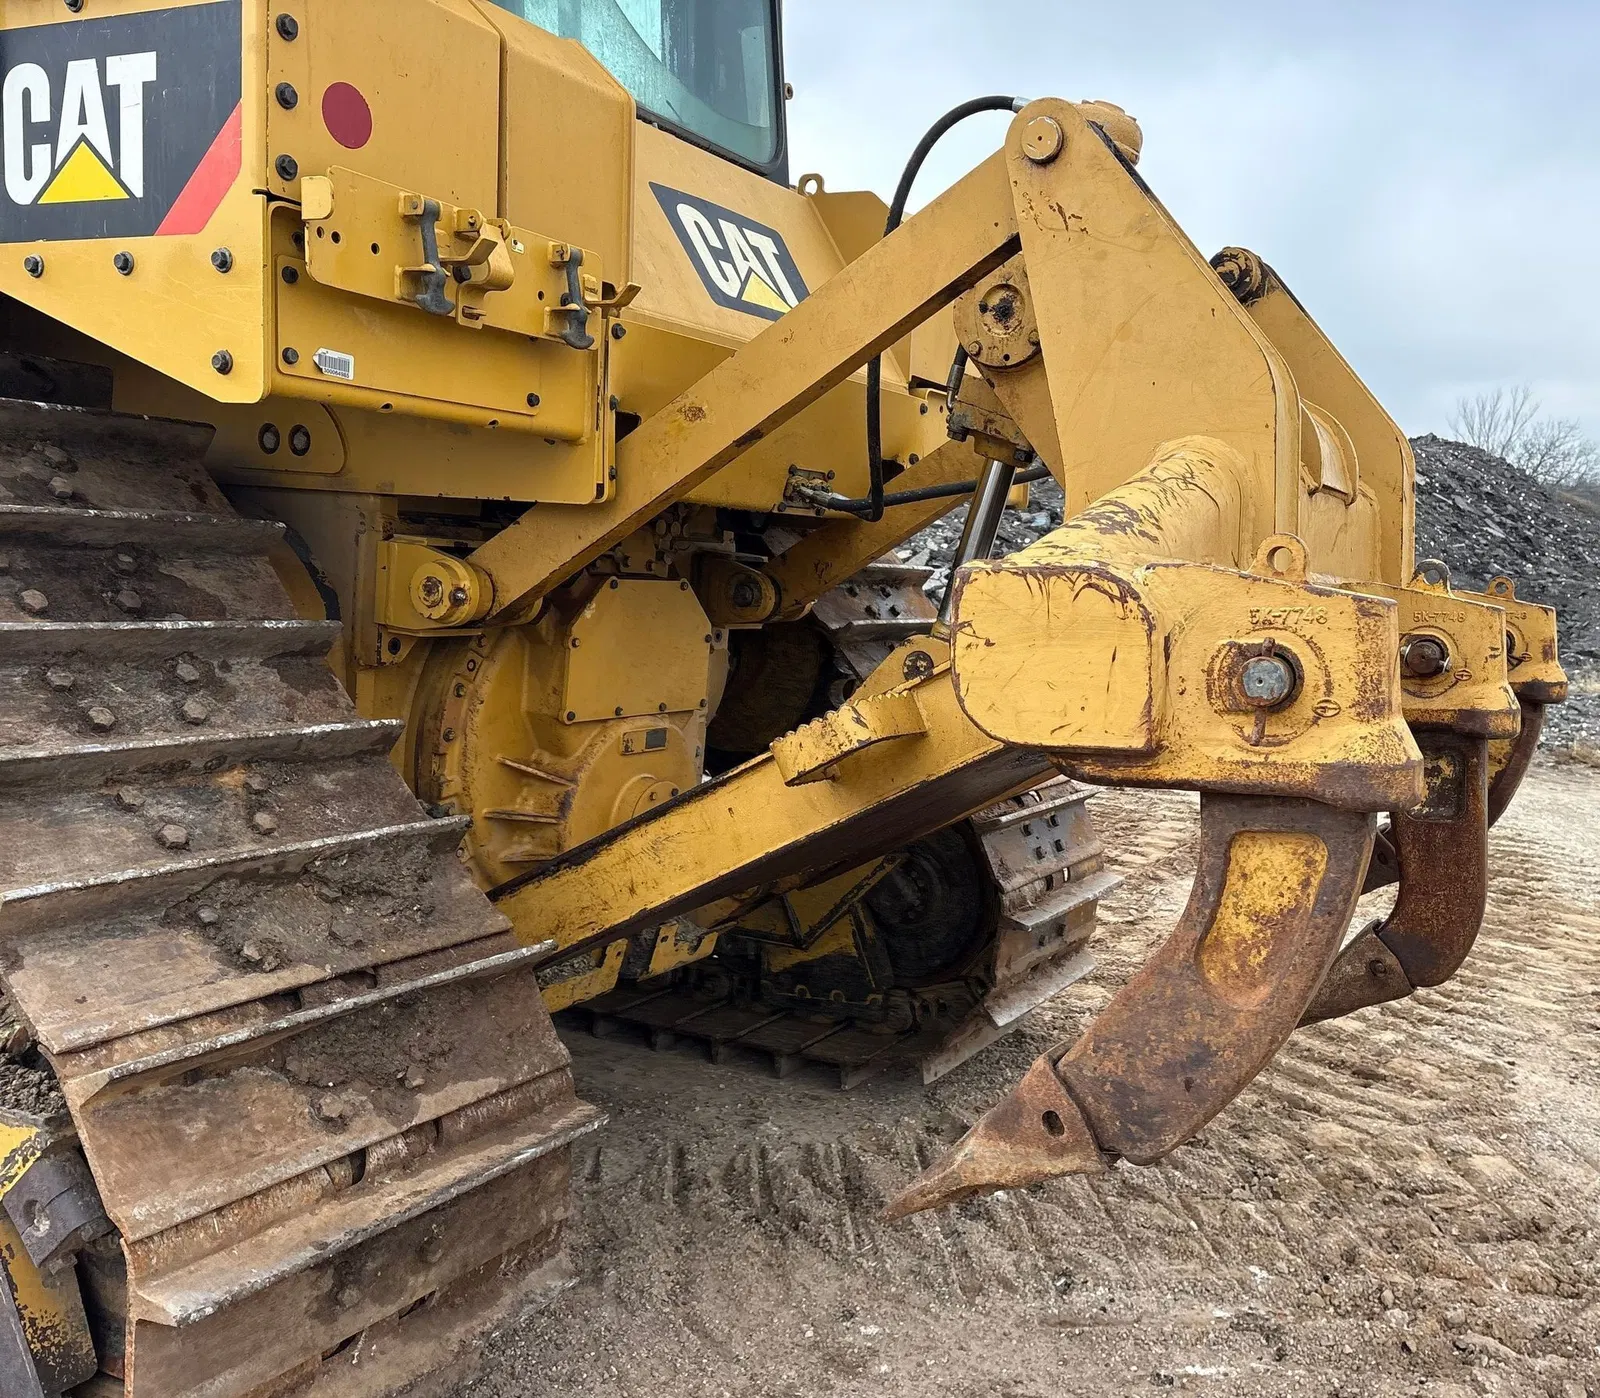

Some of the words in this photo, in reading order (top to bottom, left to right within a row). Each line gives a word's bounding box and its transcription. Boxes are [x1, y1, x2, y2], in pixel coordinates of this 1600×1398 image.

[3, 50, 157, 206] CAT
[676, 203, 800, 309] CAT
[1412, 610, 1467, 623] 5K-7748
